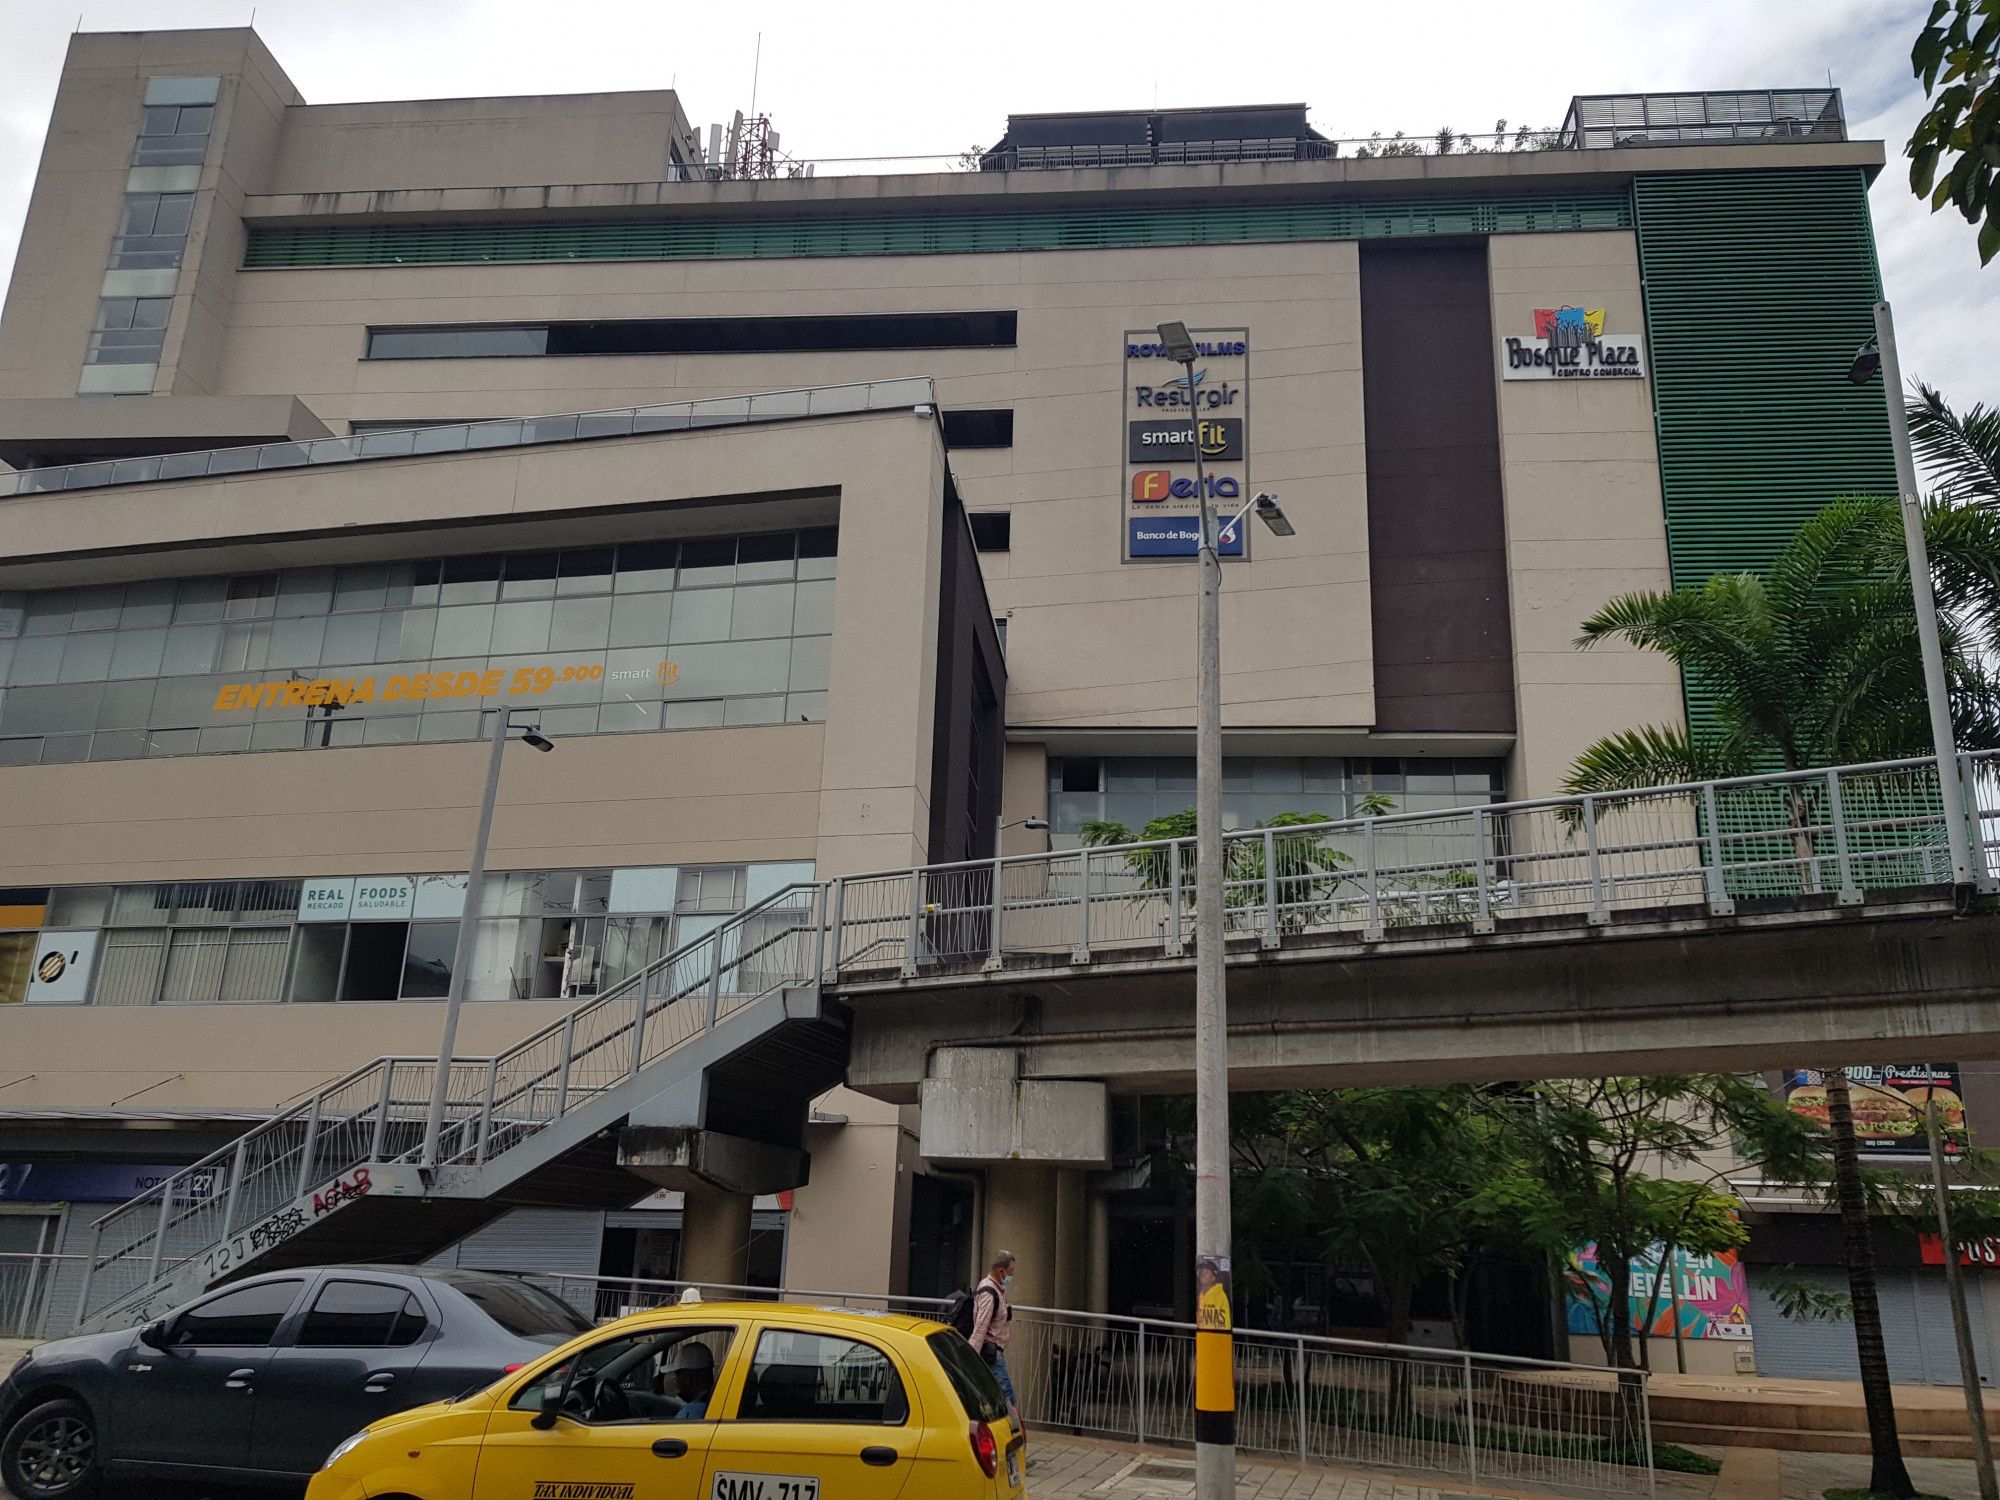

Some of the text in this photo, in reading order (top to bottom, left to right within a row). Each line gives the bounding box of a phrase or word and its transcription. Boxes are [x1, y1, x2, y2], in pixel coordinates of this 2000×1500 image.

[1127, 343, 1166, 358] ROY
[1506, 337, 1640, 376] Bosque Plaza
[1557, 367, 1642, 377] CENTRO COMERCIAL
[1136, 531, 1165, 540] Banco
[1166, 529, 1178, 540] de
[213, 676, 376, 711] ENTRENA
[383, 669, 504, 701] DESDE
[611, 666, 652, 681] smart
[307, 887, 408, 901] REAL FOODS
[307, 900, 406, 910] MERCADO SALUDABLE
[534, 1484, 634, 1499] TAX INDIVIDUAL
